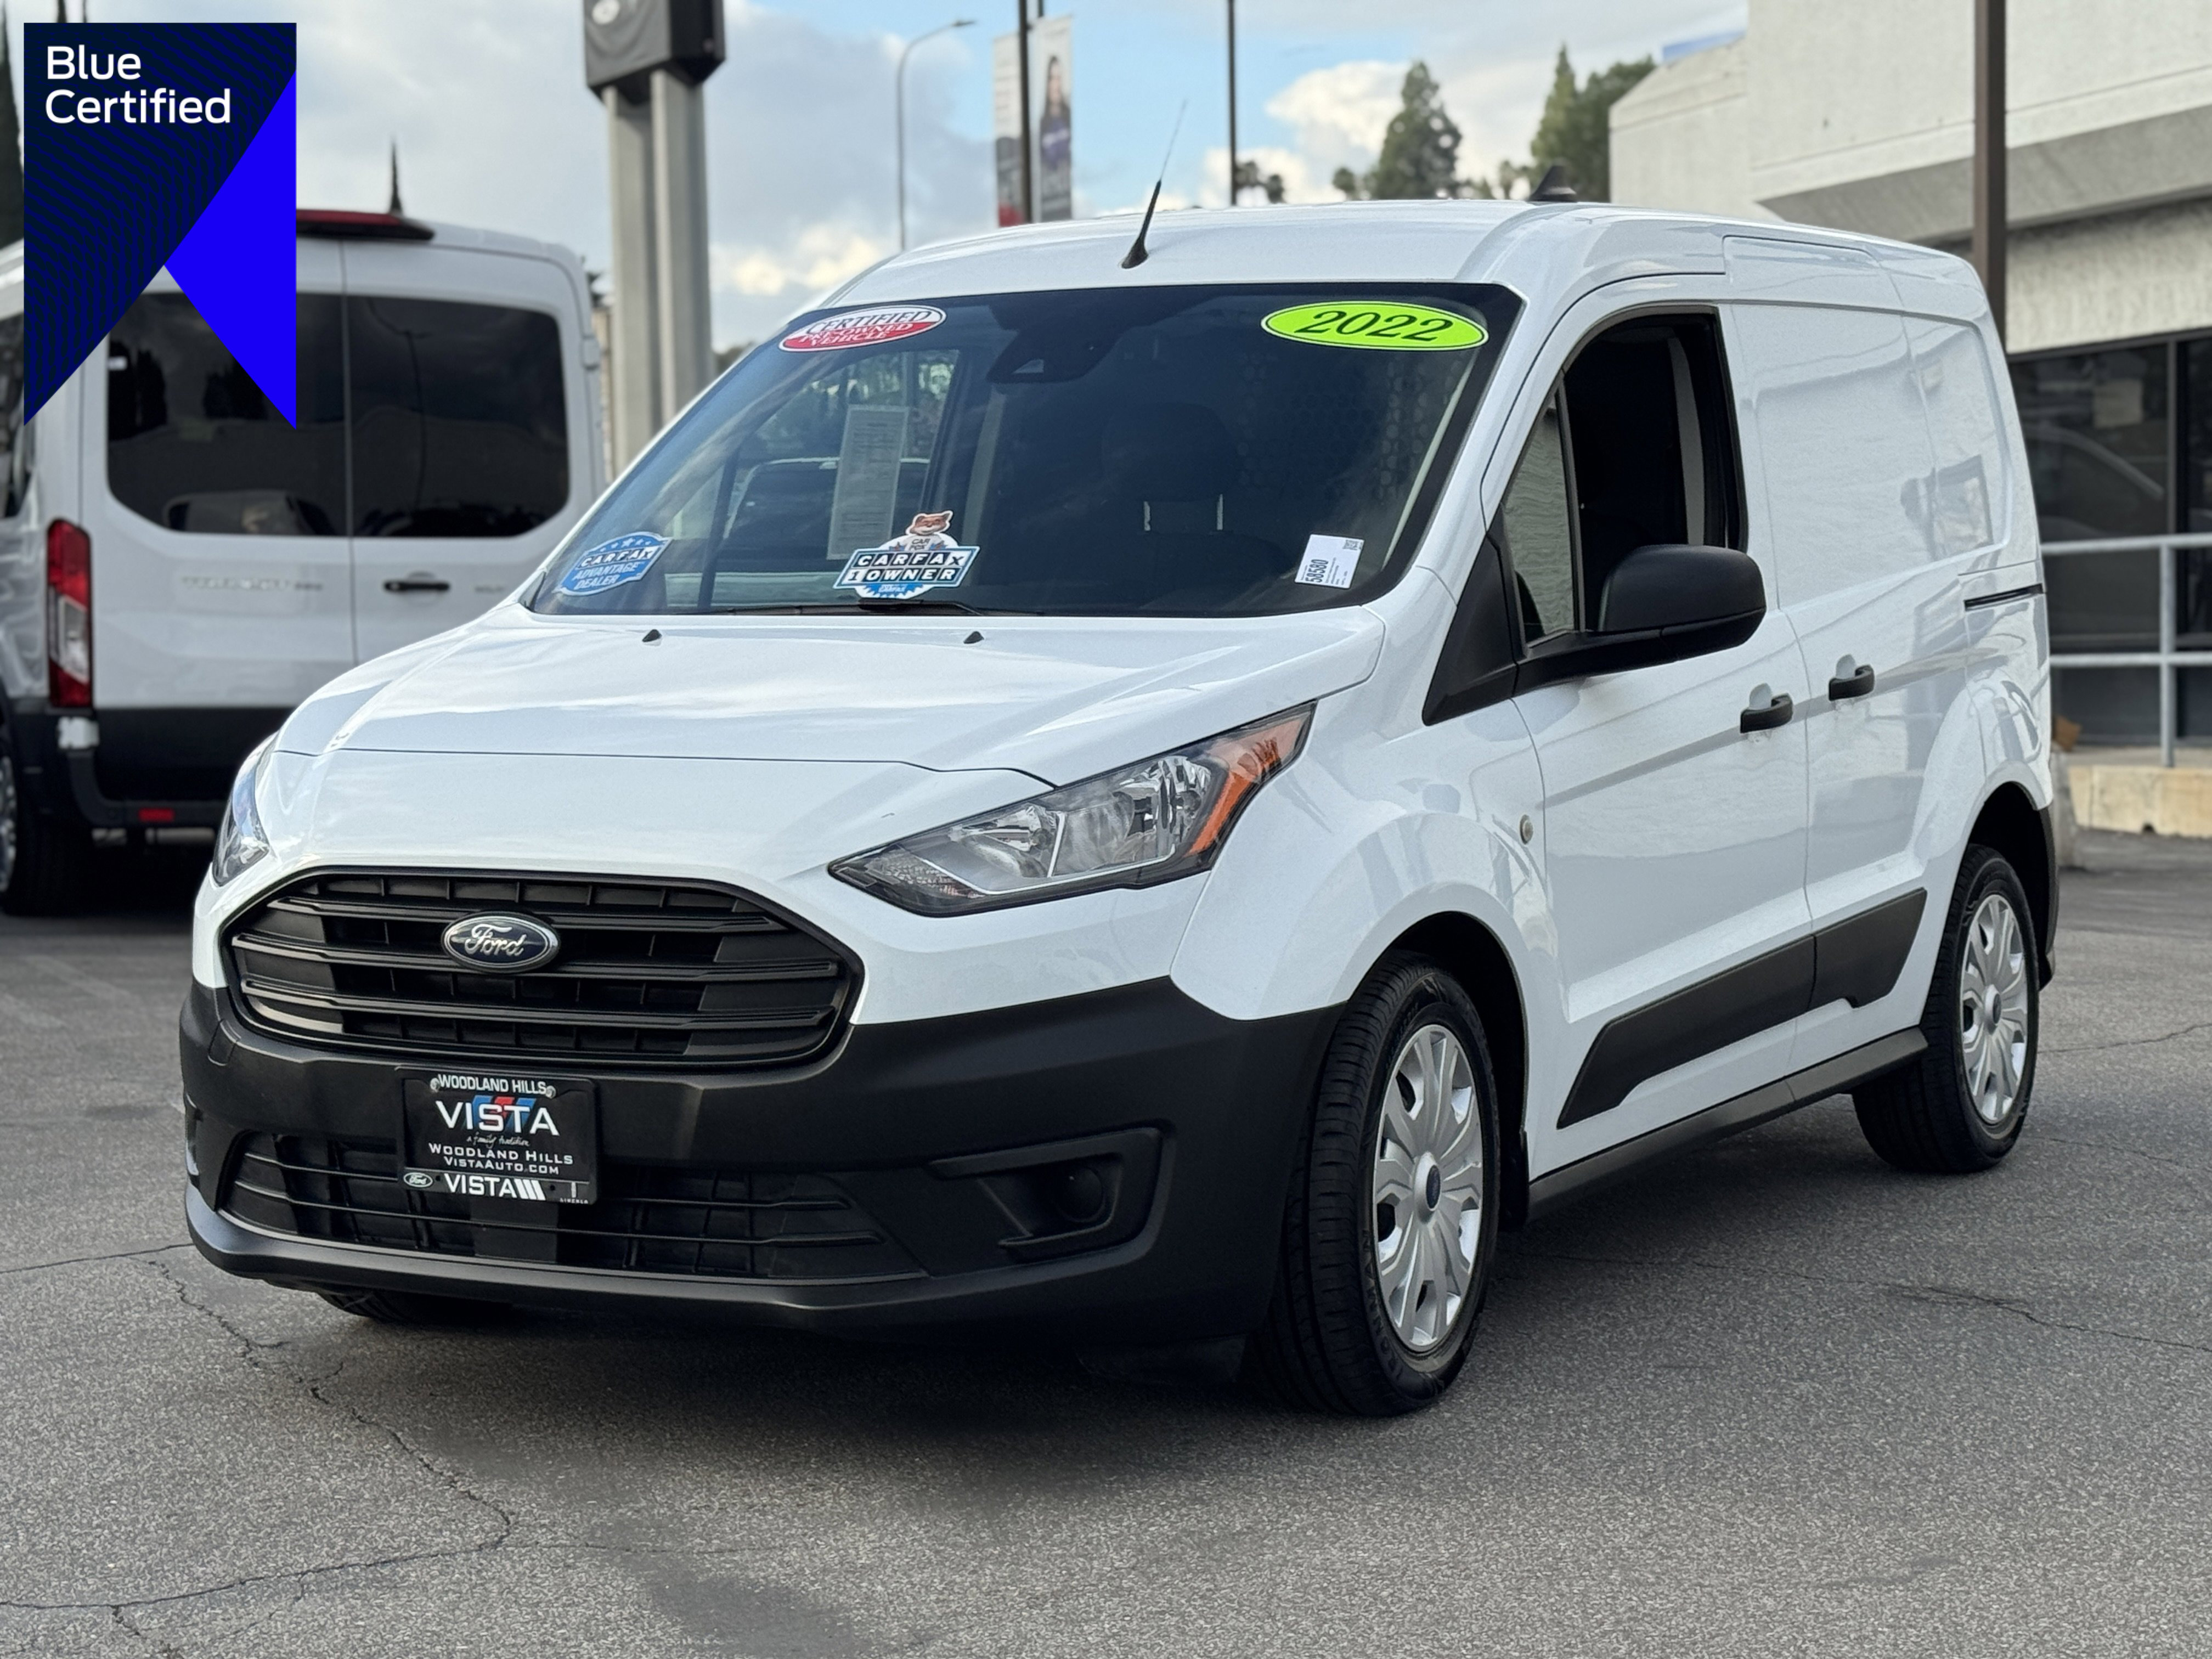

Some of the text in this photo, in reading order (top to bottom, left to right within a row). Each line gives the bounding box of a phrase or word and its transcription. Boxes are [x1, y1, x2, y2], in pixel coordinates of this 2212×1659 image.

[806, 311, 932, 334] CERTIFIED
[1294, 311, 1454, 341] 2022
[581, 548, 657, 567] CARFAX
[857, 552, 964, 566] CARFAX
[574, 574, 620, 590] DEALER
[575, 562, 639, 580] ADVANTAGE
[866, 569, 957, 581] OWNER
[1305, 559, 1329, 583] 58580
[465, 923, 527, 956] Ford
[438, 1074, 547, 1095] WOODLAND HILLS
[435, 1100, 560, 1136] VISTA
[428, 1142, 574, 1165] WOODLAND HILLS
[444, 1173, 517, 1198] VISTA
